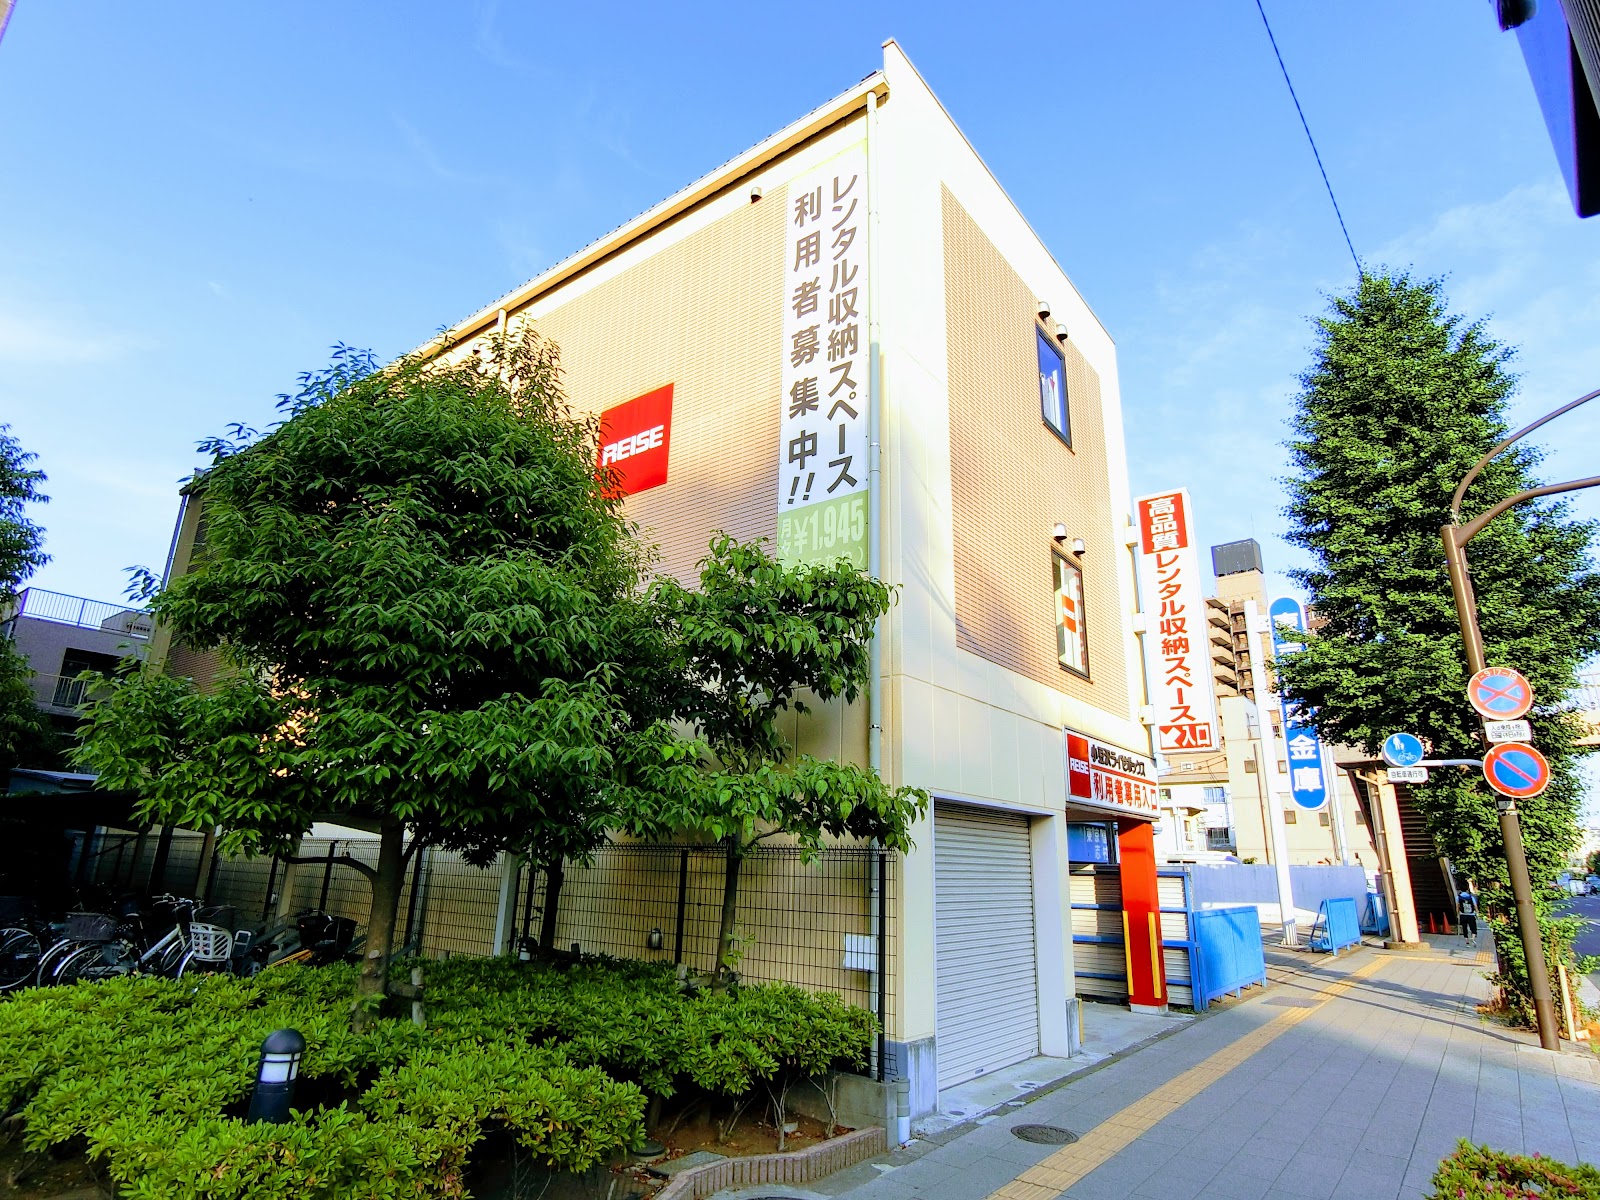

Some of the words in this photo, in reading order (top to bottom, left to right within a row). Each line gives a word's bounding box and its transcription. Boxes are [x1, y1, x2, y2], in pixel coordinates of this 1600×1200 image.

[787, 185, 822, 505] 利用者募集中!!
[826, 173, 860, 495] レンタル収納スペース
[601, 424, 664, 467] REISE
[793, 498, 865, 555] ¥1,945
[1146, 496, 1180, 552] 高品質
[1155, 553, 1197, 723] レンタル収納スペース
[1181, 724, 1211, 747] 入口
[1069, 757, 1090, 775] REISE
[1093, 772, 1158, 811] 利用者専用入口
